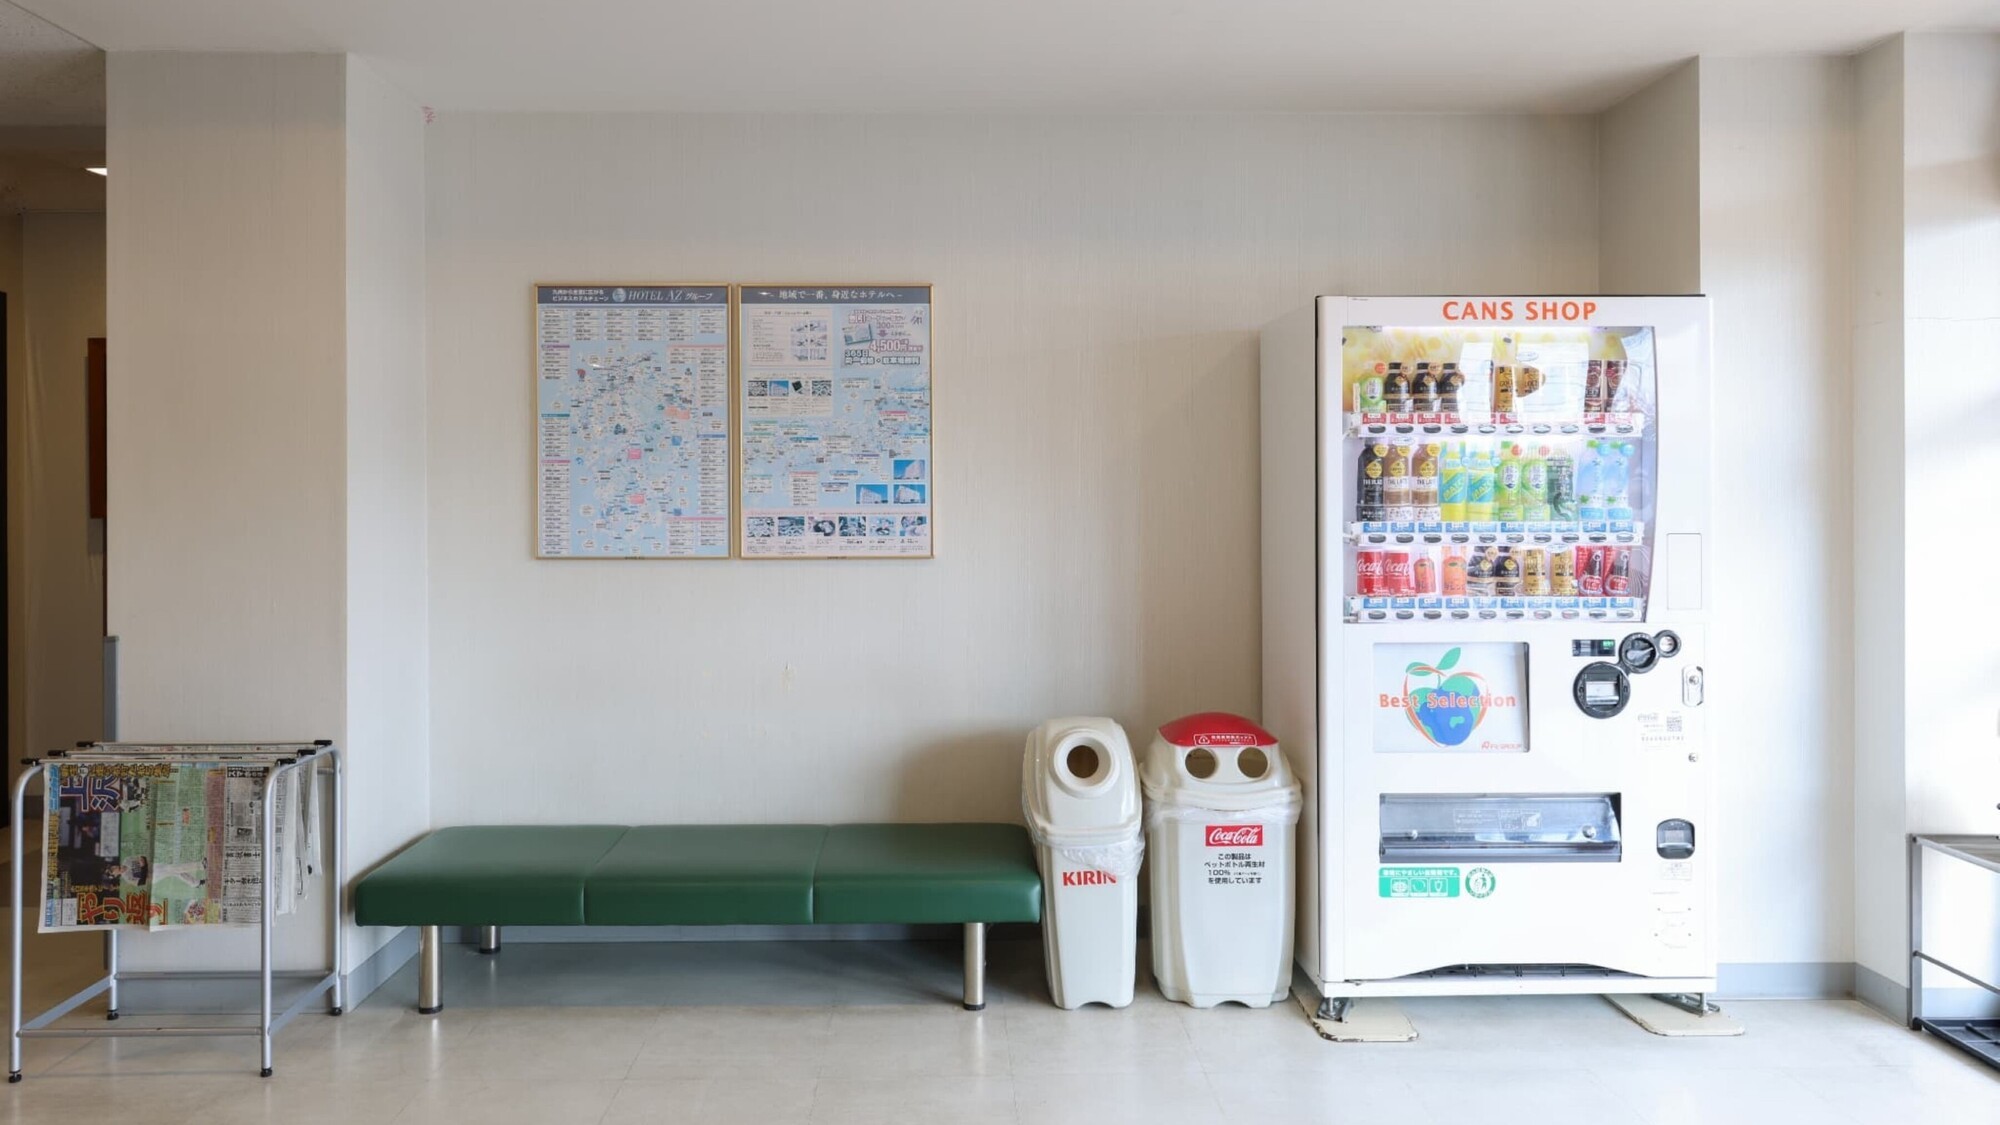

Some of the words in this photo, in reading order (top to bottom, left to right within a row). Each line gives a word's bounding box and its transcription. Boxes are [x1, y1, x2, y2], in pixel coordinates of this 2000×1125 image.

[628, 292, 664, 301] HOTEL
[666, 290, 682, 301] AZ
[1442, 301, 1514, 320] CANS
[1525, 301, 1597, 320] SHOP
[1380, 693, 1419, 708] Best
[1426, 693, 1516, 708] Selection
[1208, 827, 1261, 844] Coca-Cola
[1062, 870, 1117, 887] KIRIN
